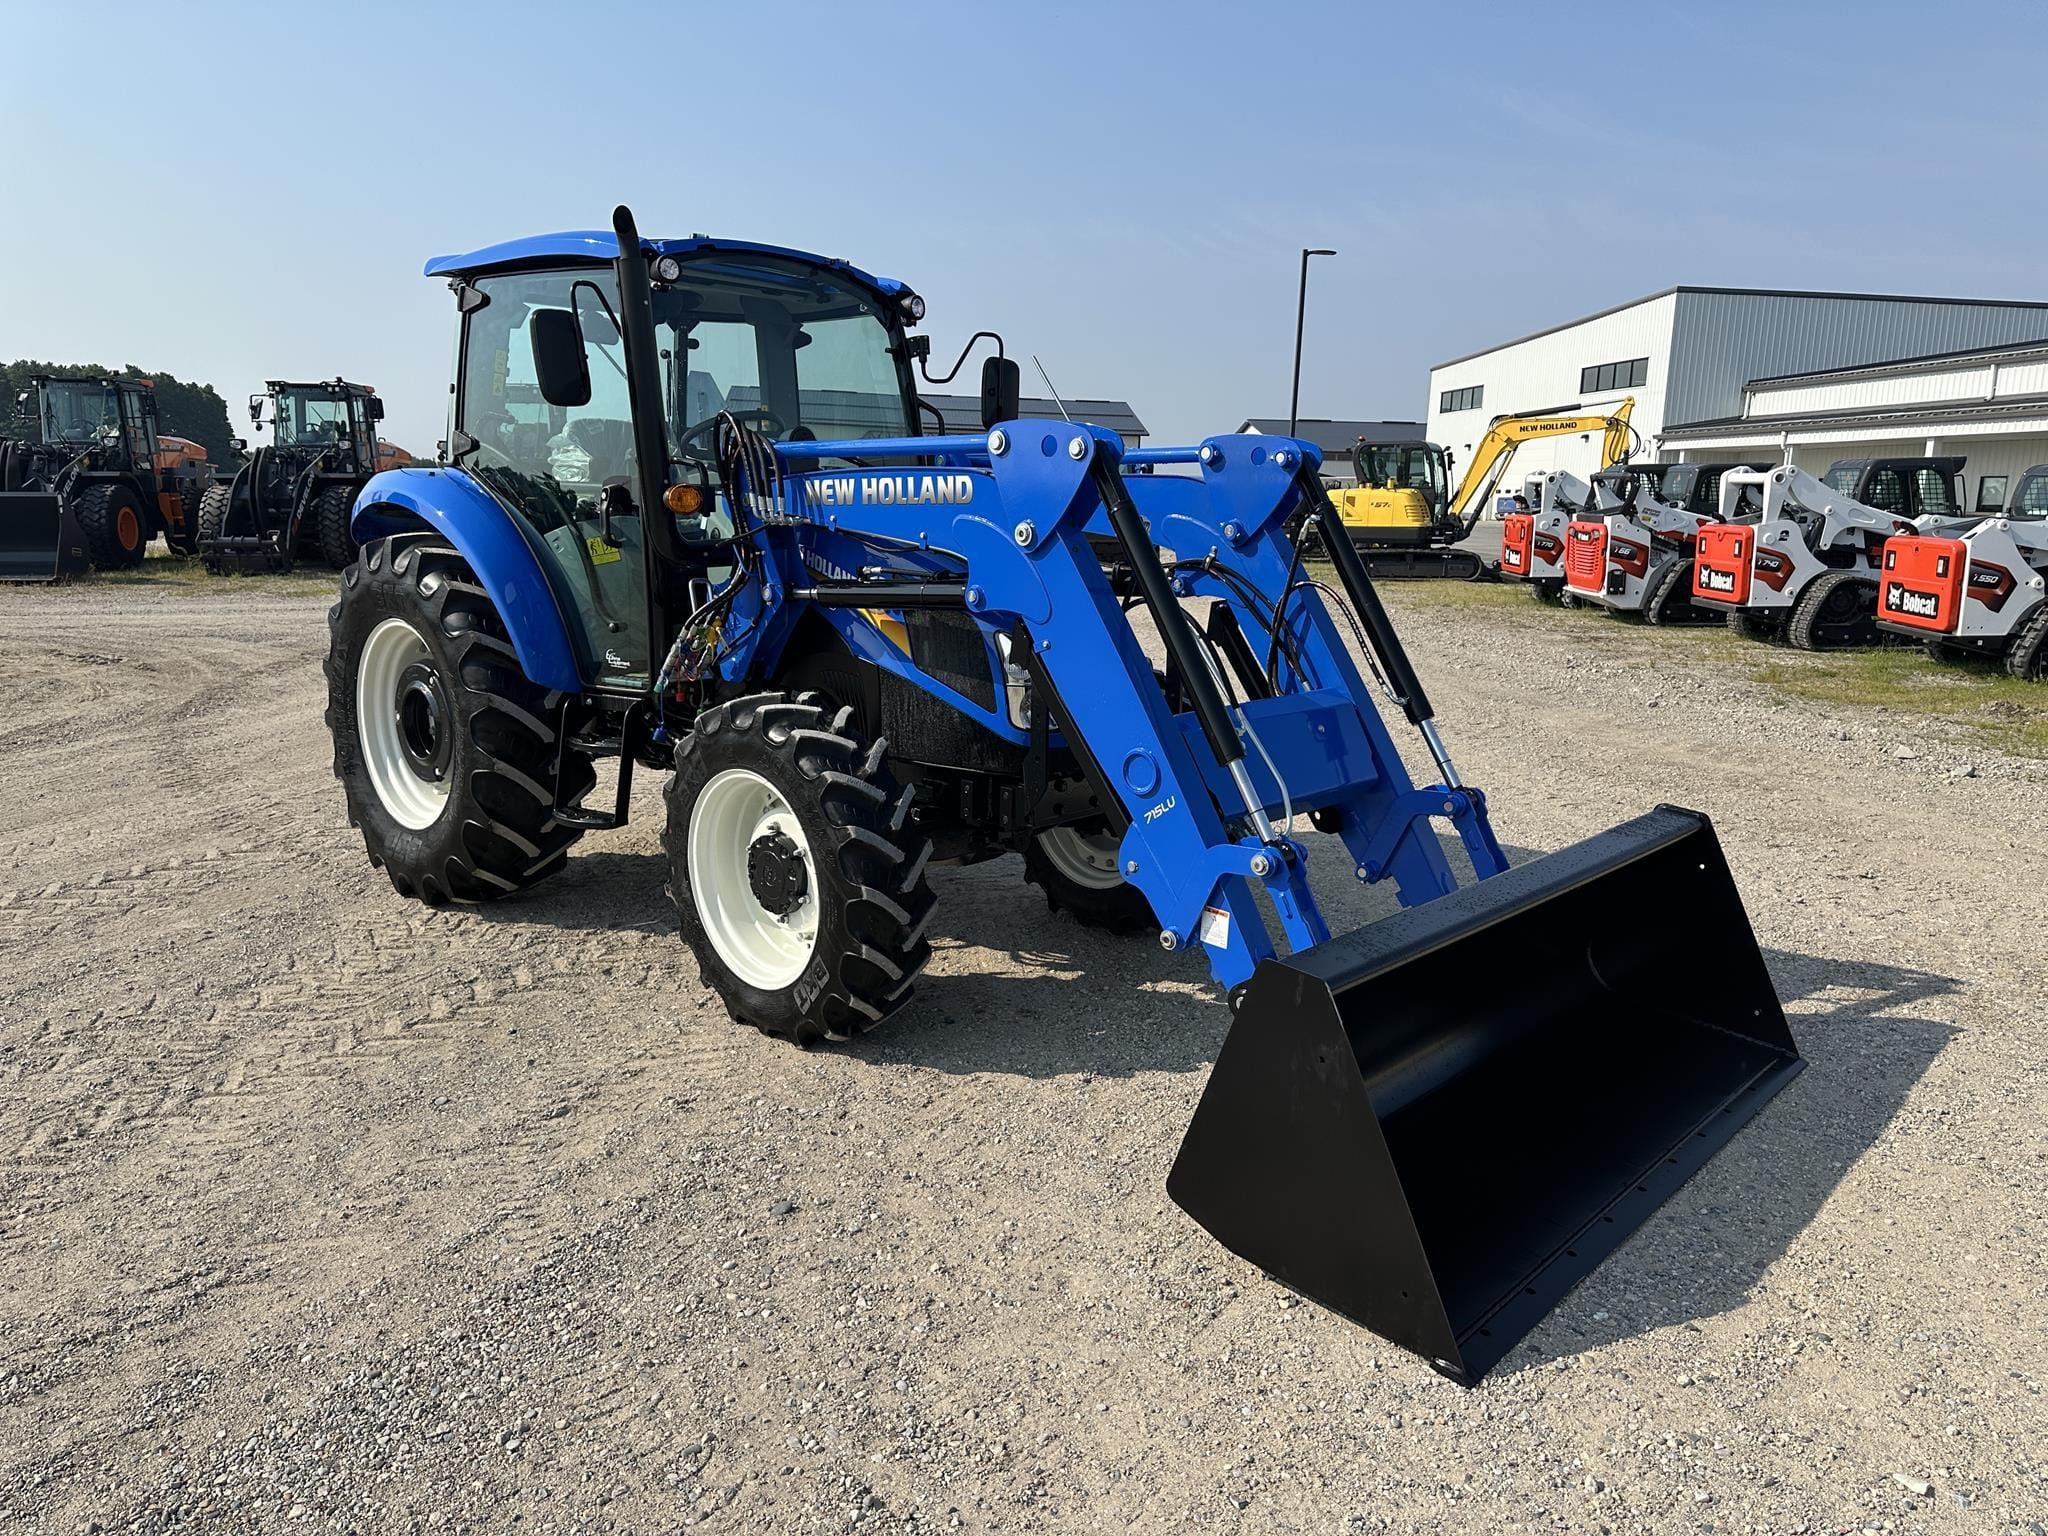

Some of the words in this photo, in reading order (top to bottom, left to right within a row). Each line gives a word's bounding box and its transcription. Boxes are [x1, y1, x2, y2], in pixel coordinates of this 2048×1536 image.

[1519, 424, 1538, 432] NEW
[1540, 421, 1577, 431] HOLLAND
[61, 464, 80, 498] VELON
[805, 478, 855, 506] NEW
[861, 475, 973, 505] HOLLAND
[806, 550, 857, 580] HOLLAN
[1710, 571, 1733, 591] Bobcat
[1902, 591, 1936, 616] Bobcat
[1143, 795, 1177, 825] 715LU
